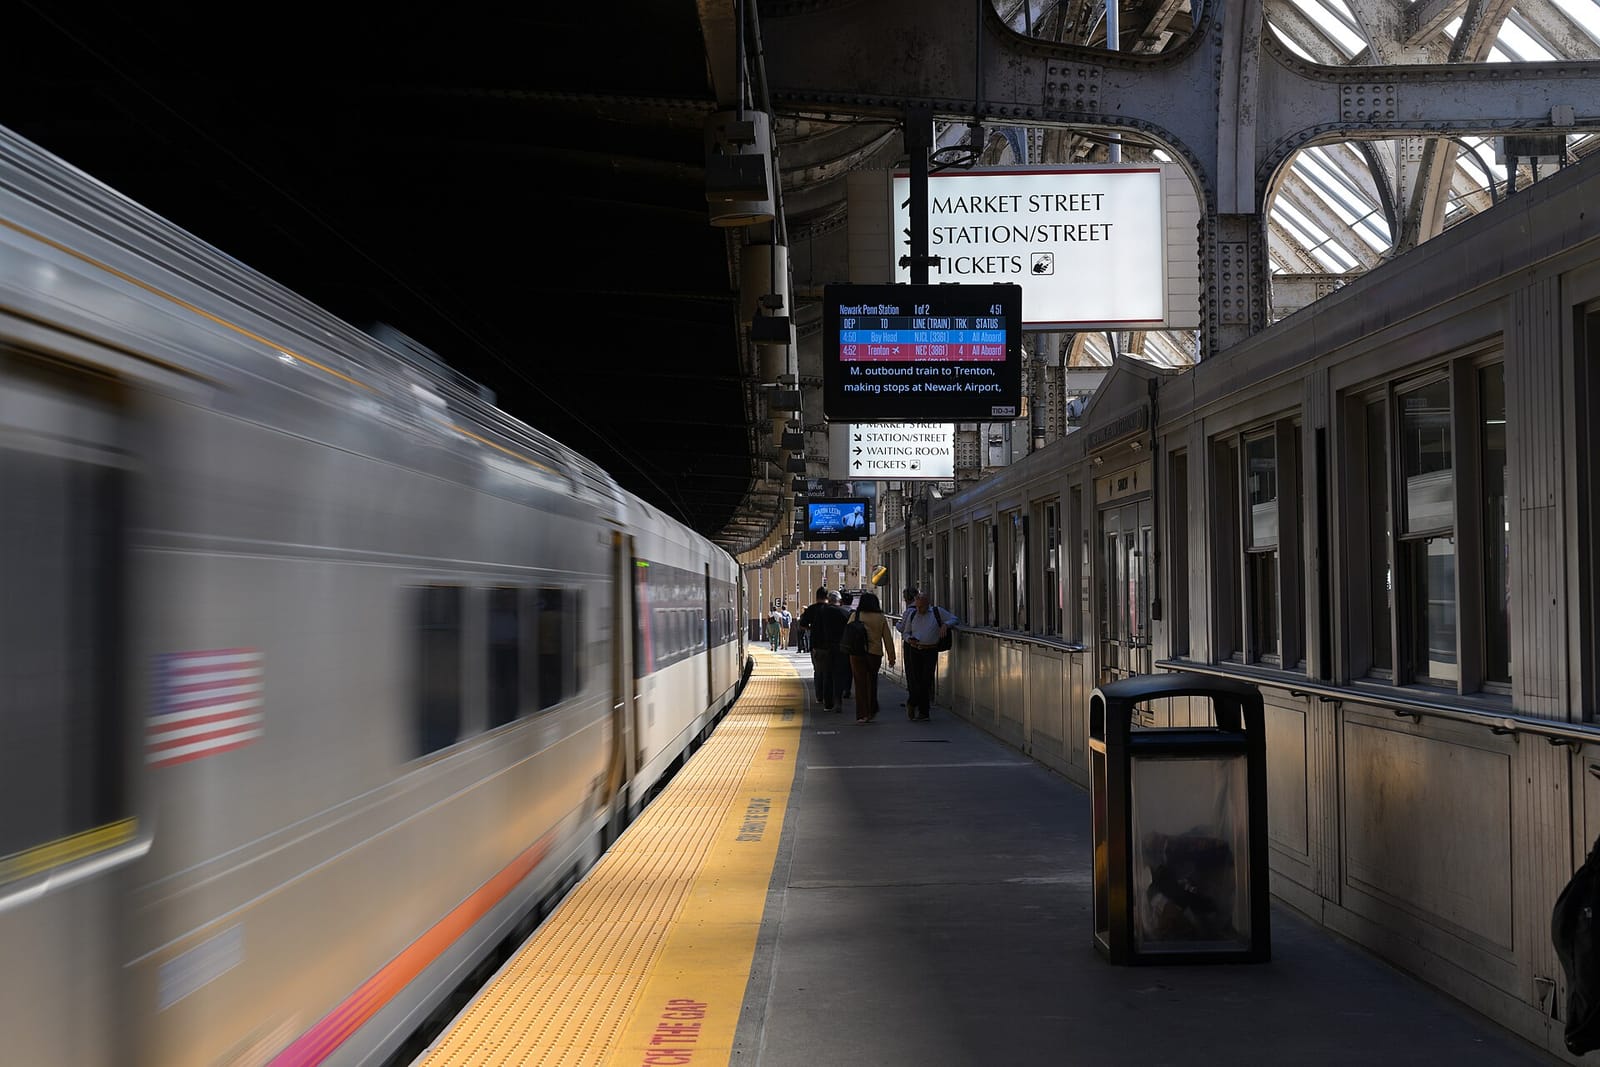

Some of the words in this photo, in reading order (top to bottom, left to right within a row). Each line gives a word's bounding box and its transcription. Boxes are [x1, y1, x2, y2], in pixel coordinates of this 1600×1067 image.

[932, 195, 1022, 214] MARKET
[1028, 193, 1105, 213] STREET
[932, 223, 1113, 244] STATION/STREET
[937, 255, 1022, 274] TICKETS
[839, 304, 862, 315] Newark
[863, 304, 878, 315] Penn
[878, 304, 900, 315] Station
[918, 304, 925, 315] of
[925, 304, 930, 315] 2
[843, 318, 856, 329] DEP
[880, 318, 889, 329] TO
[912, 318, 926, 329] LINE
[927, 317, 951, 330] (TRAIN)
[955, 318, 968, 329] TRK
[975, 318, 999, 329] STATUS
[870, 331, 882, 344] Bay
[882, 331, 898, 342] Head
[914, 331, 928, 342] NJCL
[958, 331, 964, 342] 3
[971, 331, 980, 342] All
[980, 331, 1002, 342] Aboard
[842, 345, 857, 356] 4:52
[868, 345, 890, 356] Trenton
[915, 345, 928, 356] NEC
[958, 345, 964, 356] 4
[971, 345, 980, 356] All
[980, 345, 1002, 356] Aboard
[850, 366, 863, 376] M.
[865, 366, 914, 376] outbound
[916, 366, 939, 376] train
[941, 367, 952, 376] to
[954, 366, 996, 377] Trenton,
[844, 383, 881, 394] making
[883, 384, 910, 394] stops
[912, 384, 922, 392] at
[924, 383, 962, 392] Newark
[964, 383, 1002, 394] Airport,
[866, 433, 947, 442] STATION/STREET
[866, 447, 912, 455] WAITING
[915, 447, 949, 455] ROOM
[866, 460, 907, 469] TICKETS
[661, 999, 708, 1020] GAP
[649, 1023, 701, 1045] THE
